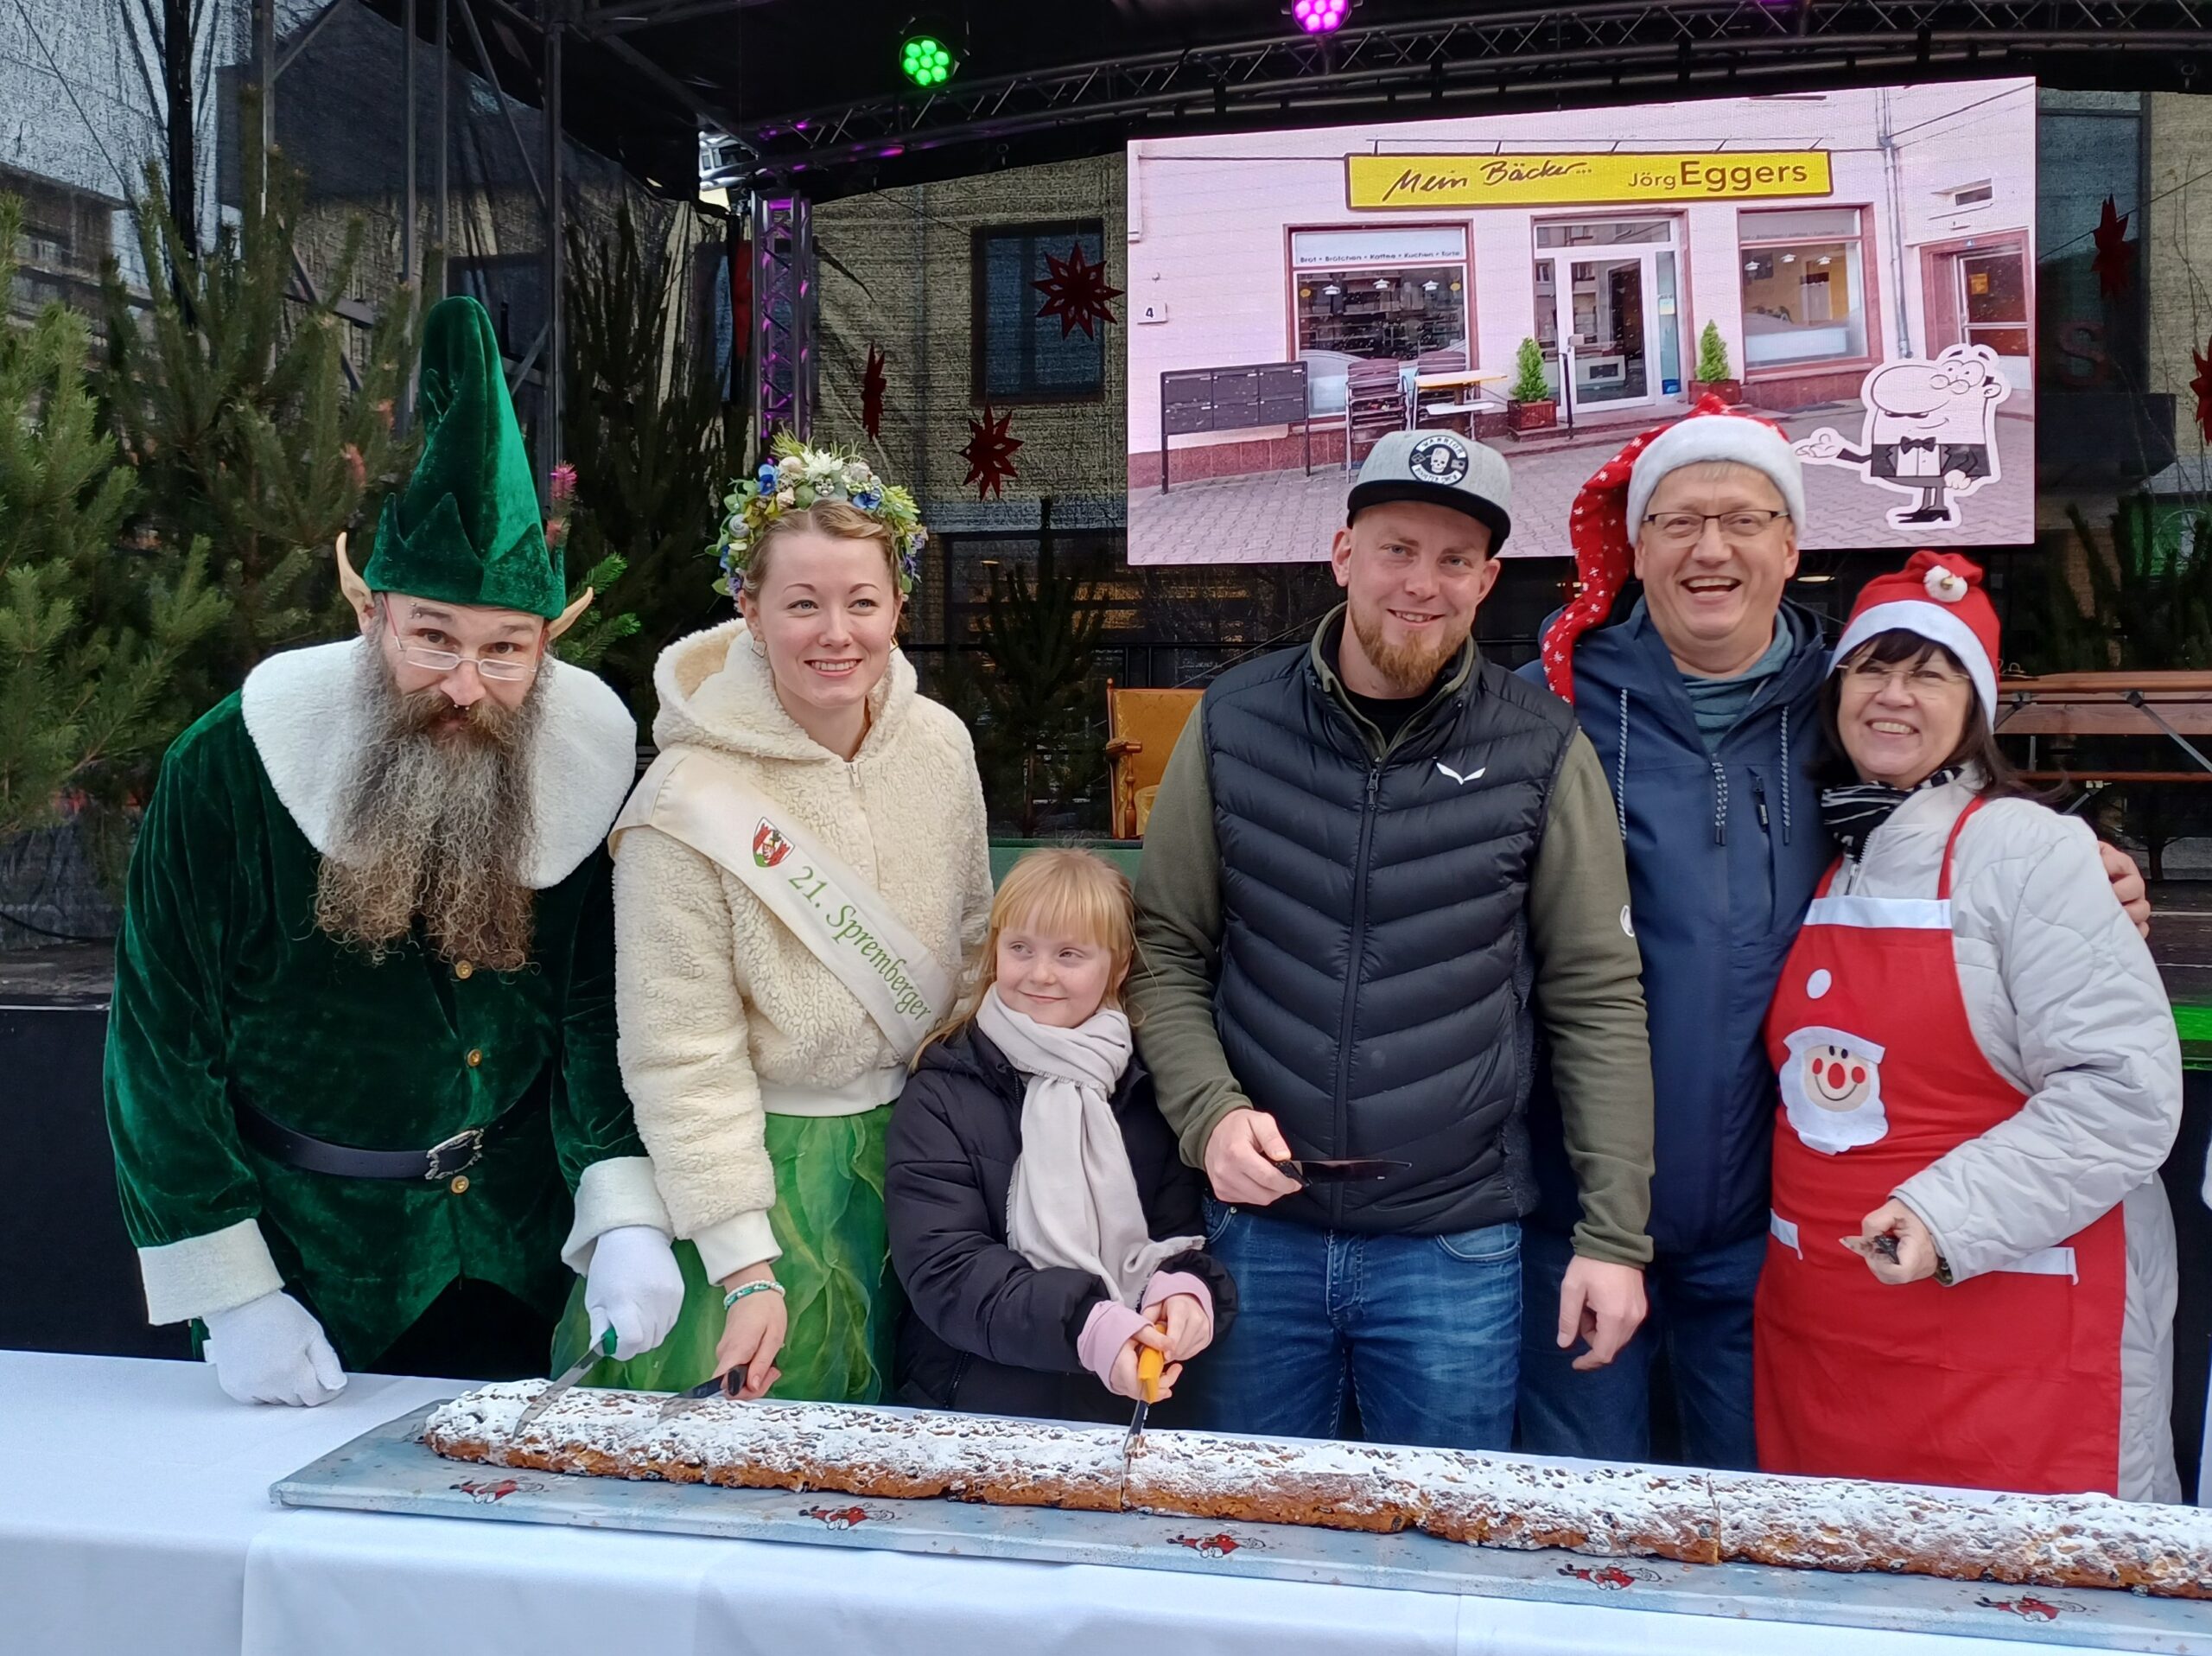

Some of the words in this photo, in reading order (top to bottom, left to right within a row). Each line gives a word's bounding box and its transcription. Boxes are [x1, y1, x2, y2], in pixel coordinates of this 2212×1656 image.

[1382, 169, 1467, 202] Mein
[1628, 172, 1676, 190] Jörg
[1680, 160, 1808, 192] Eggers
[1145, 307, 1154, 318] 4
[787, 865, 828, 908] 21.
[826, 904, 931, 1022] Spremberger
